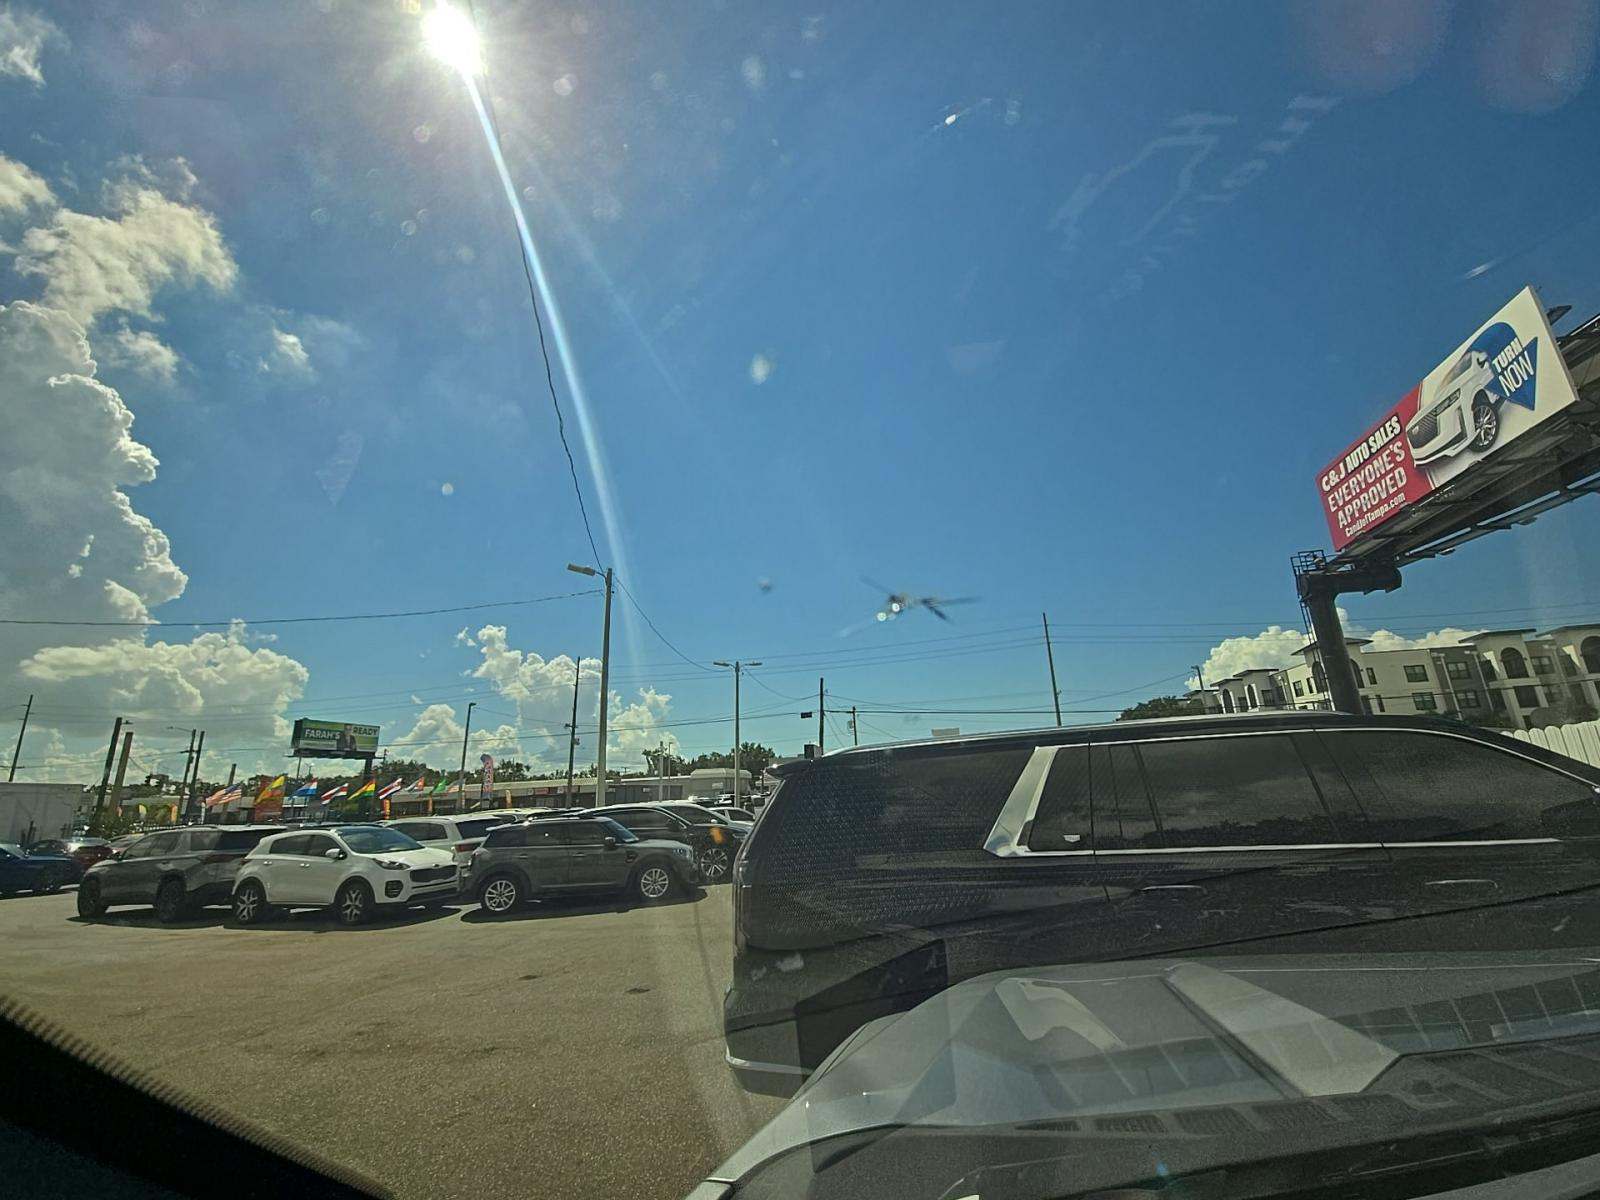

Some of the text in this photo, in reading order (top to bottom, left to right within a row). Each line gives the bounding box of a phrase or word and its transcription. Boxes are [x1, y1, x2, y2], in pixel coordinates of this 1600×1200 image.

[1492, 337, 1523, 373] TURN
[1499, 351, 1534, 396] NOW
[1321, 415, 1401, 492] C&J AUTO SALES
[1328, 441, 1405, 513] EVERYONE'S
[1337, 467, 1407, 529] APPROVED
[304, 728, 340, 740] FARAH'S
[352, 727, 378, 736] READY
